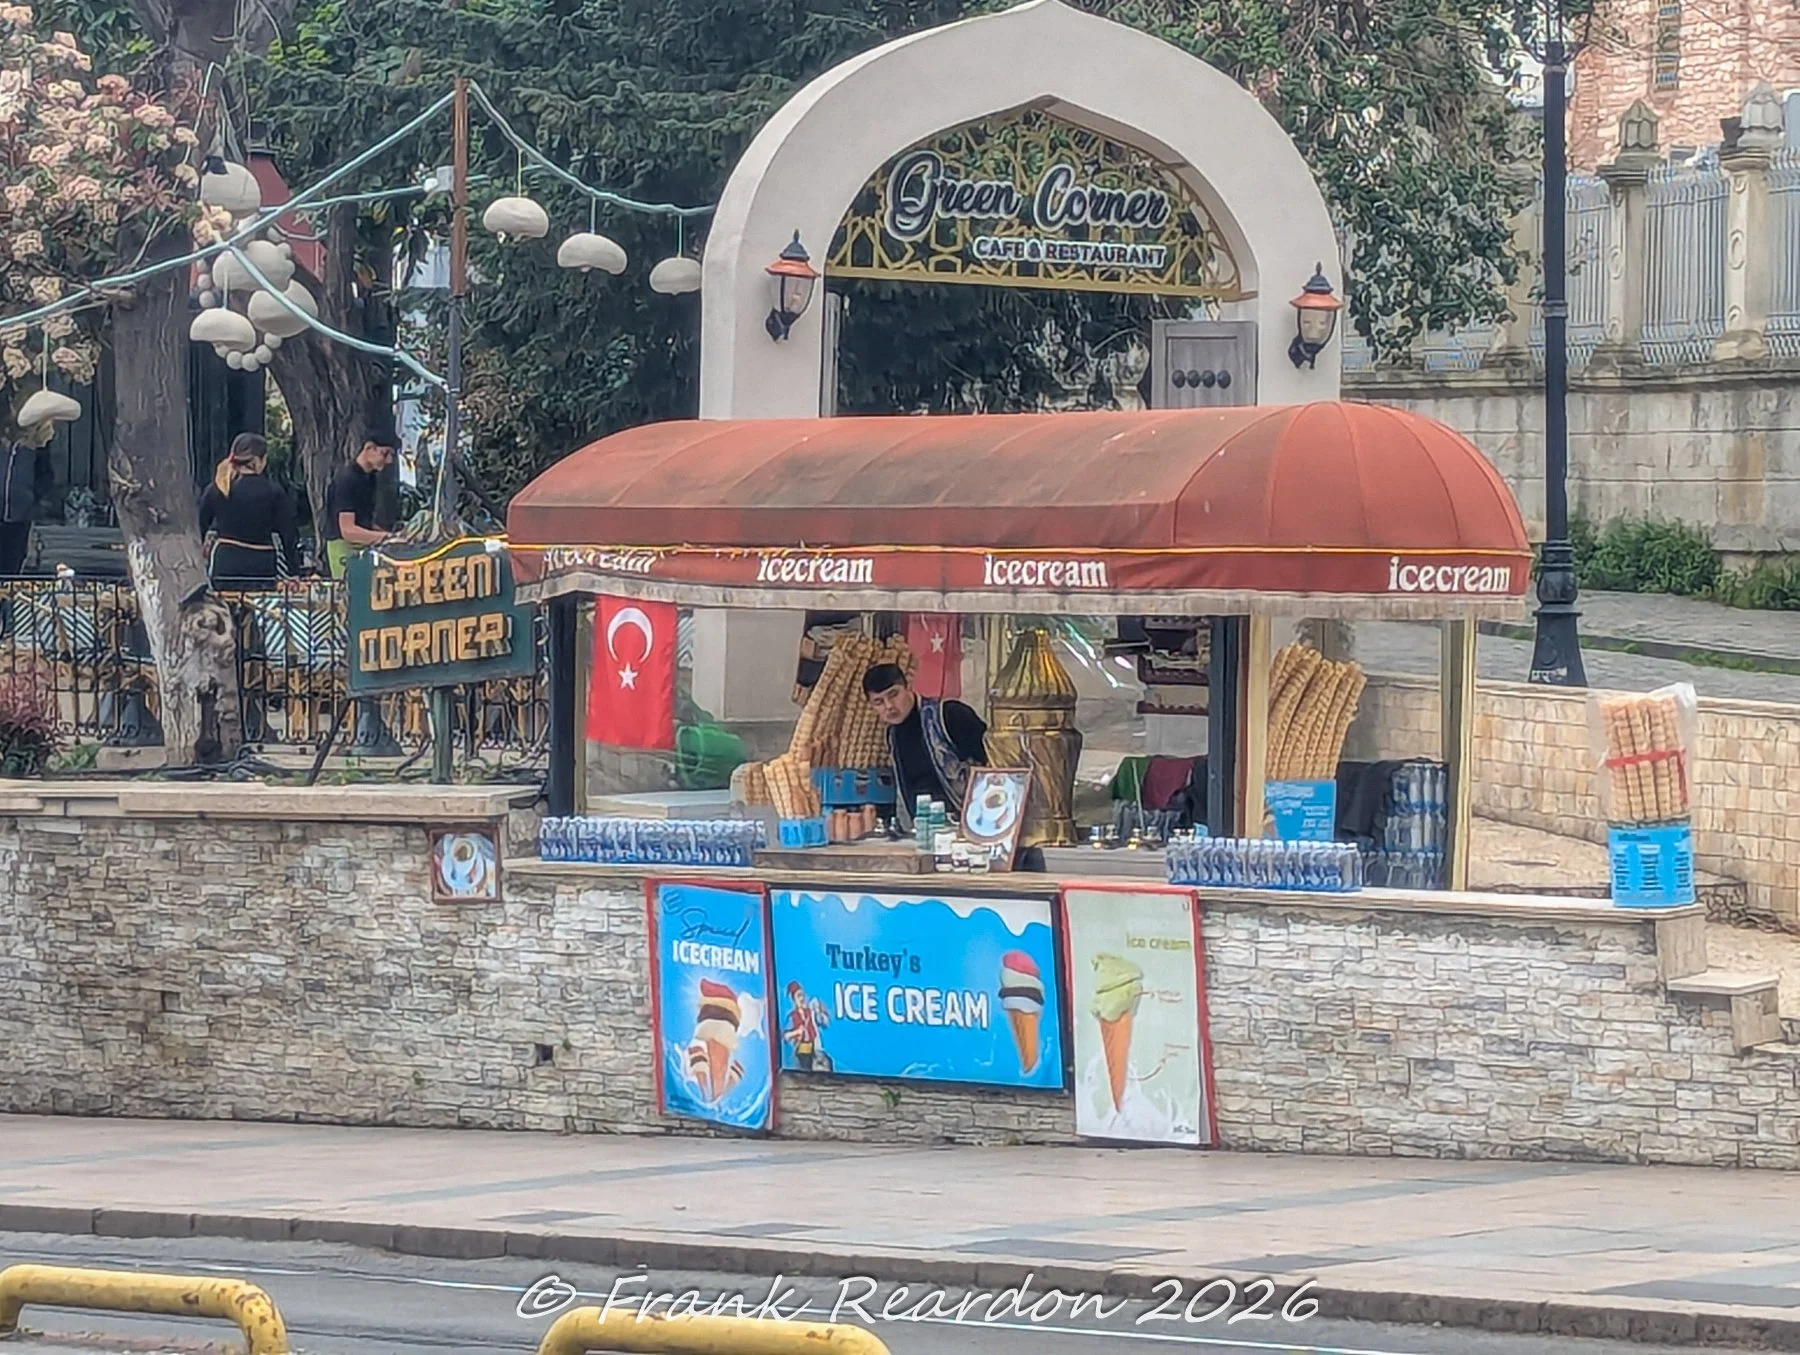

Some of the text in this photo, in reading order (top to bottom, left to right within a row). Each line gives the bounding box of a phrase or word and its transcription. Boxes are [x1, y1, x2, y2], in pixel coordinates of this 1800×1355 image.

[885, 150, 1171, 241] Green Corner
[1043, 240, 1166, 267] RESTAURANT
[371, 554, 499, 611] GREEN
[757, 554, 873, 584] icecream
[984, 553, 1109, 588] icecream
[1387, 556, 1511, 592] icecream
[359, 613, 512, 672] CORNER
[672, 940, 759, 974] ICECREAM
[826, 943, 921, 978] Turkey's
[834, 981, 989, 1030] ICE CREAM
